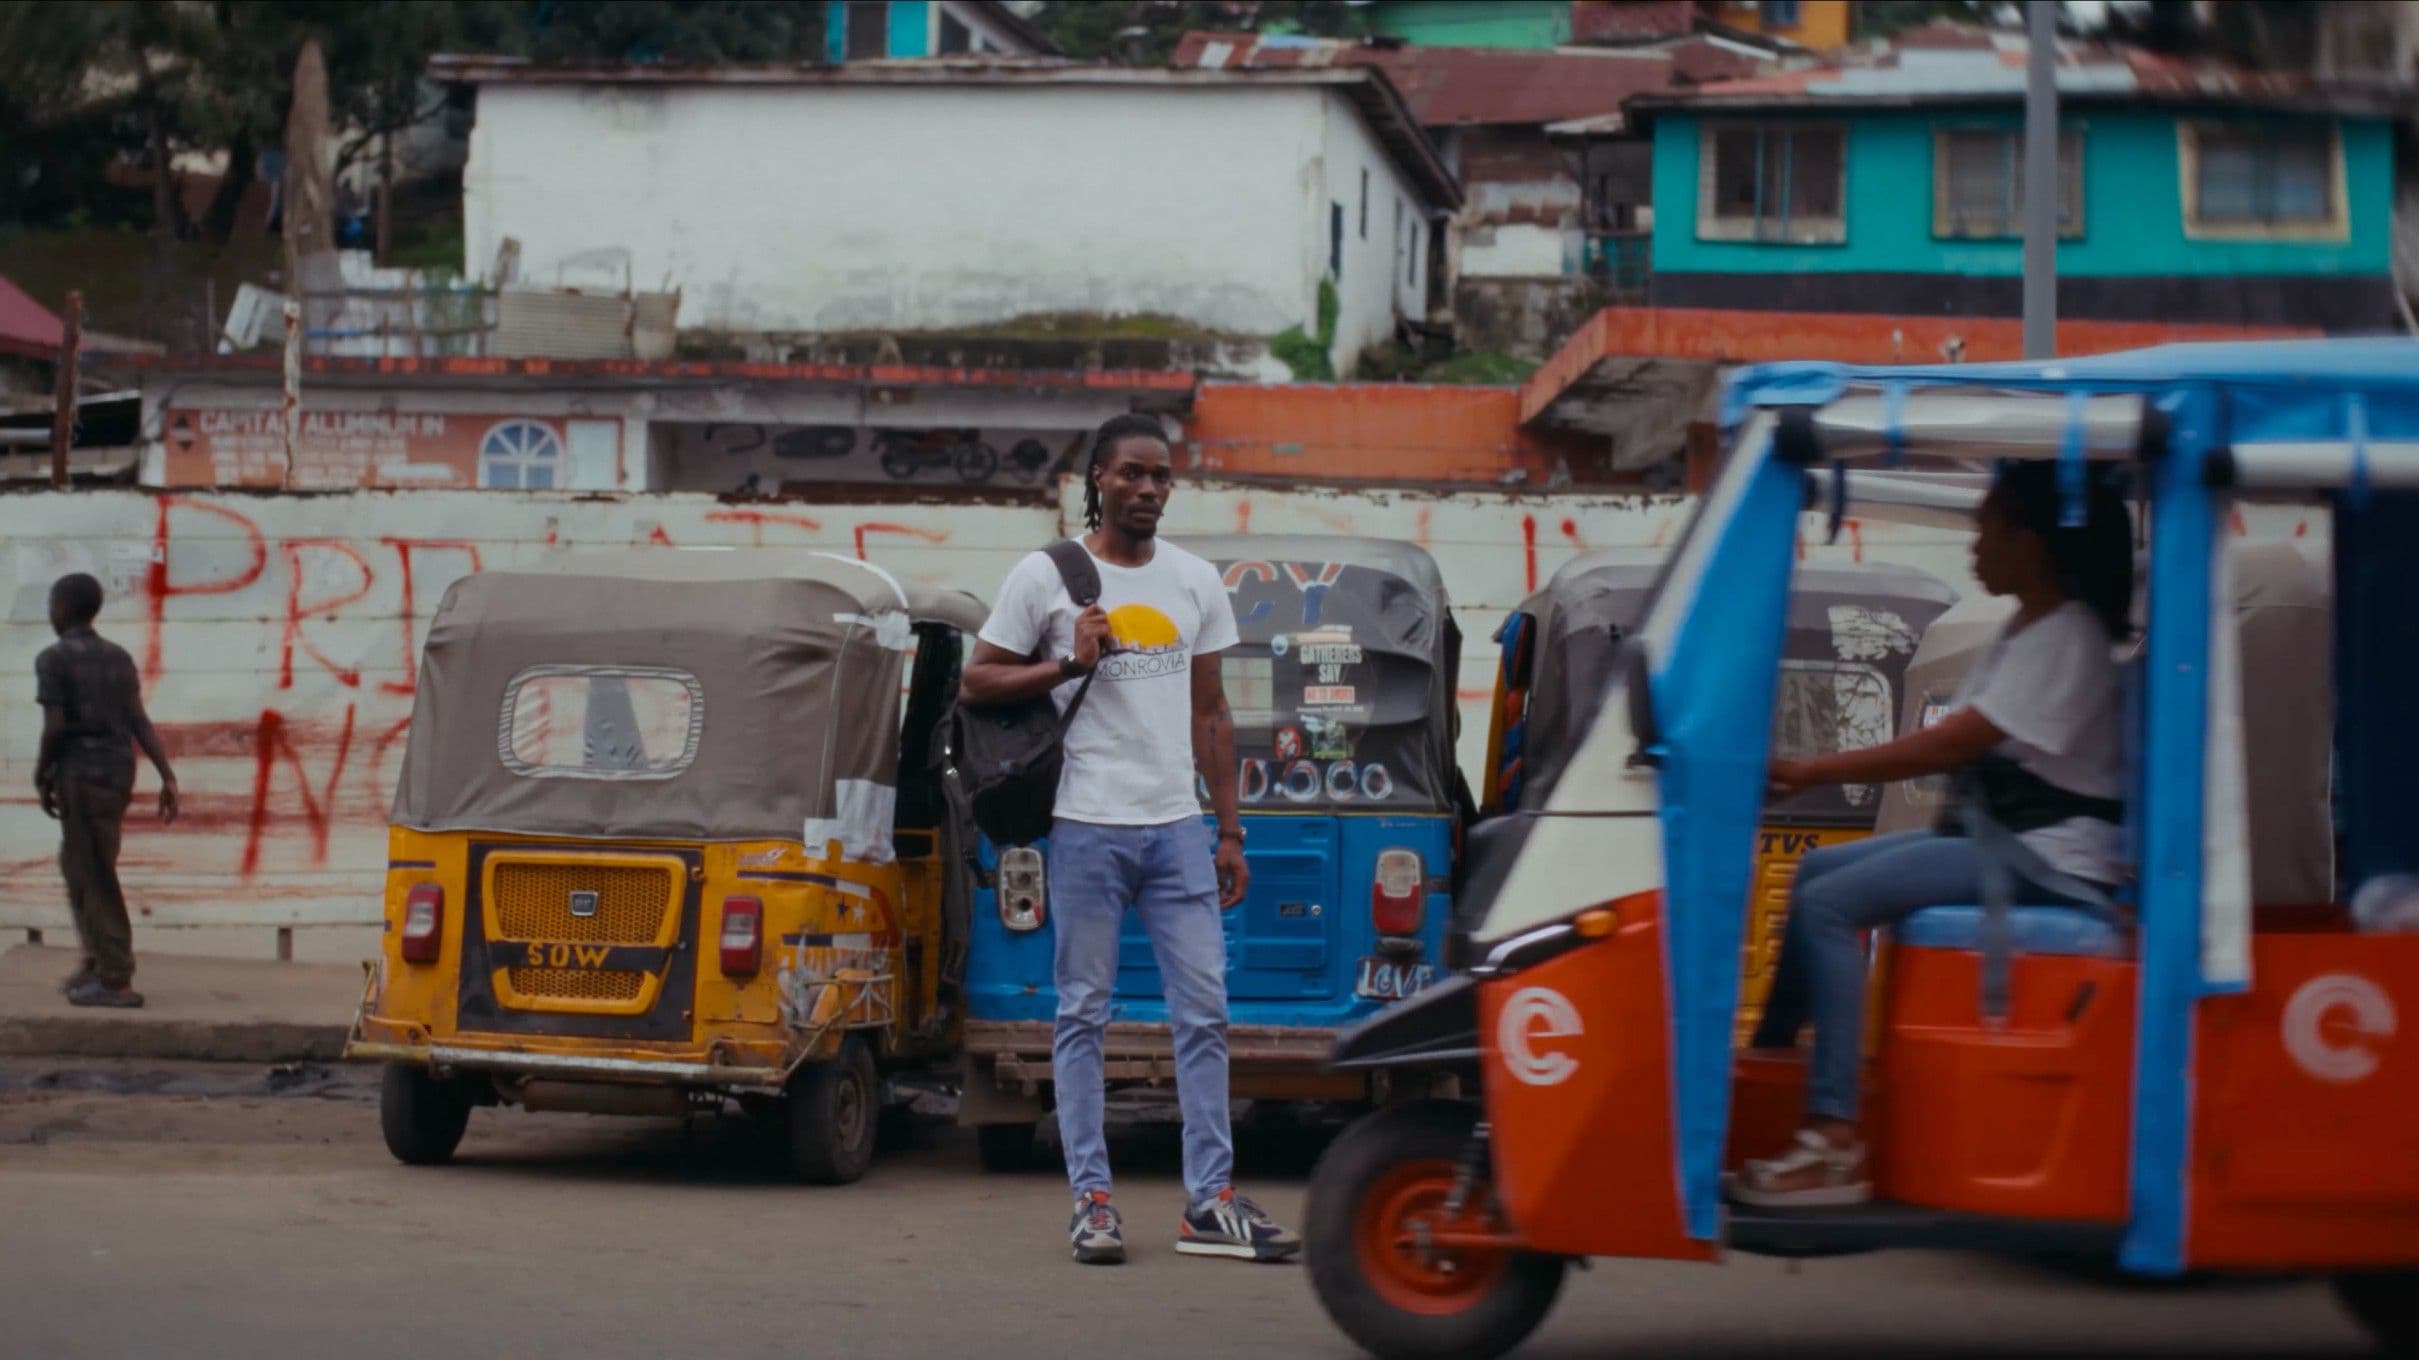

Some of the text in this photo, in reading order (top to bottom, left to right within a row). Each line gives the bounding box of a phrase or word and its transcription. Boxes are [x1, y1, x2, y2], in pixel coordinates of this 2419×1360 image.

[199, 412, 291, 433] CAPITA
[1098, 652, 1186, 677] MONROVIA
[1760, 832, 1820, 856] TVS
[528, 941, 610, 969] SOW
